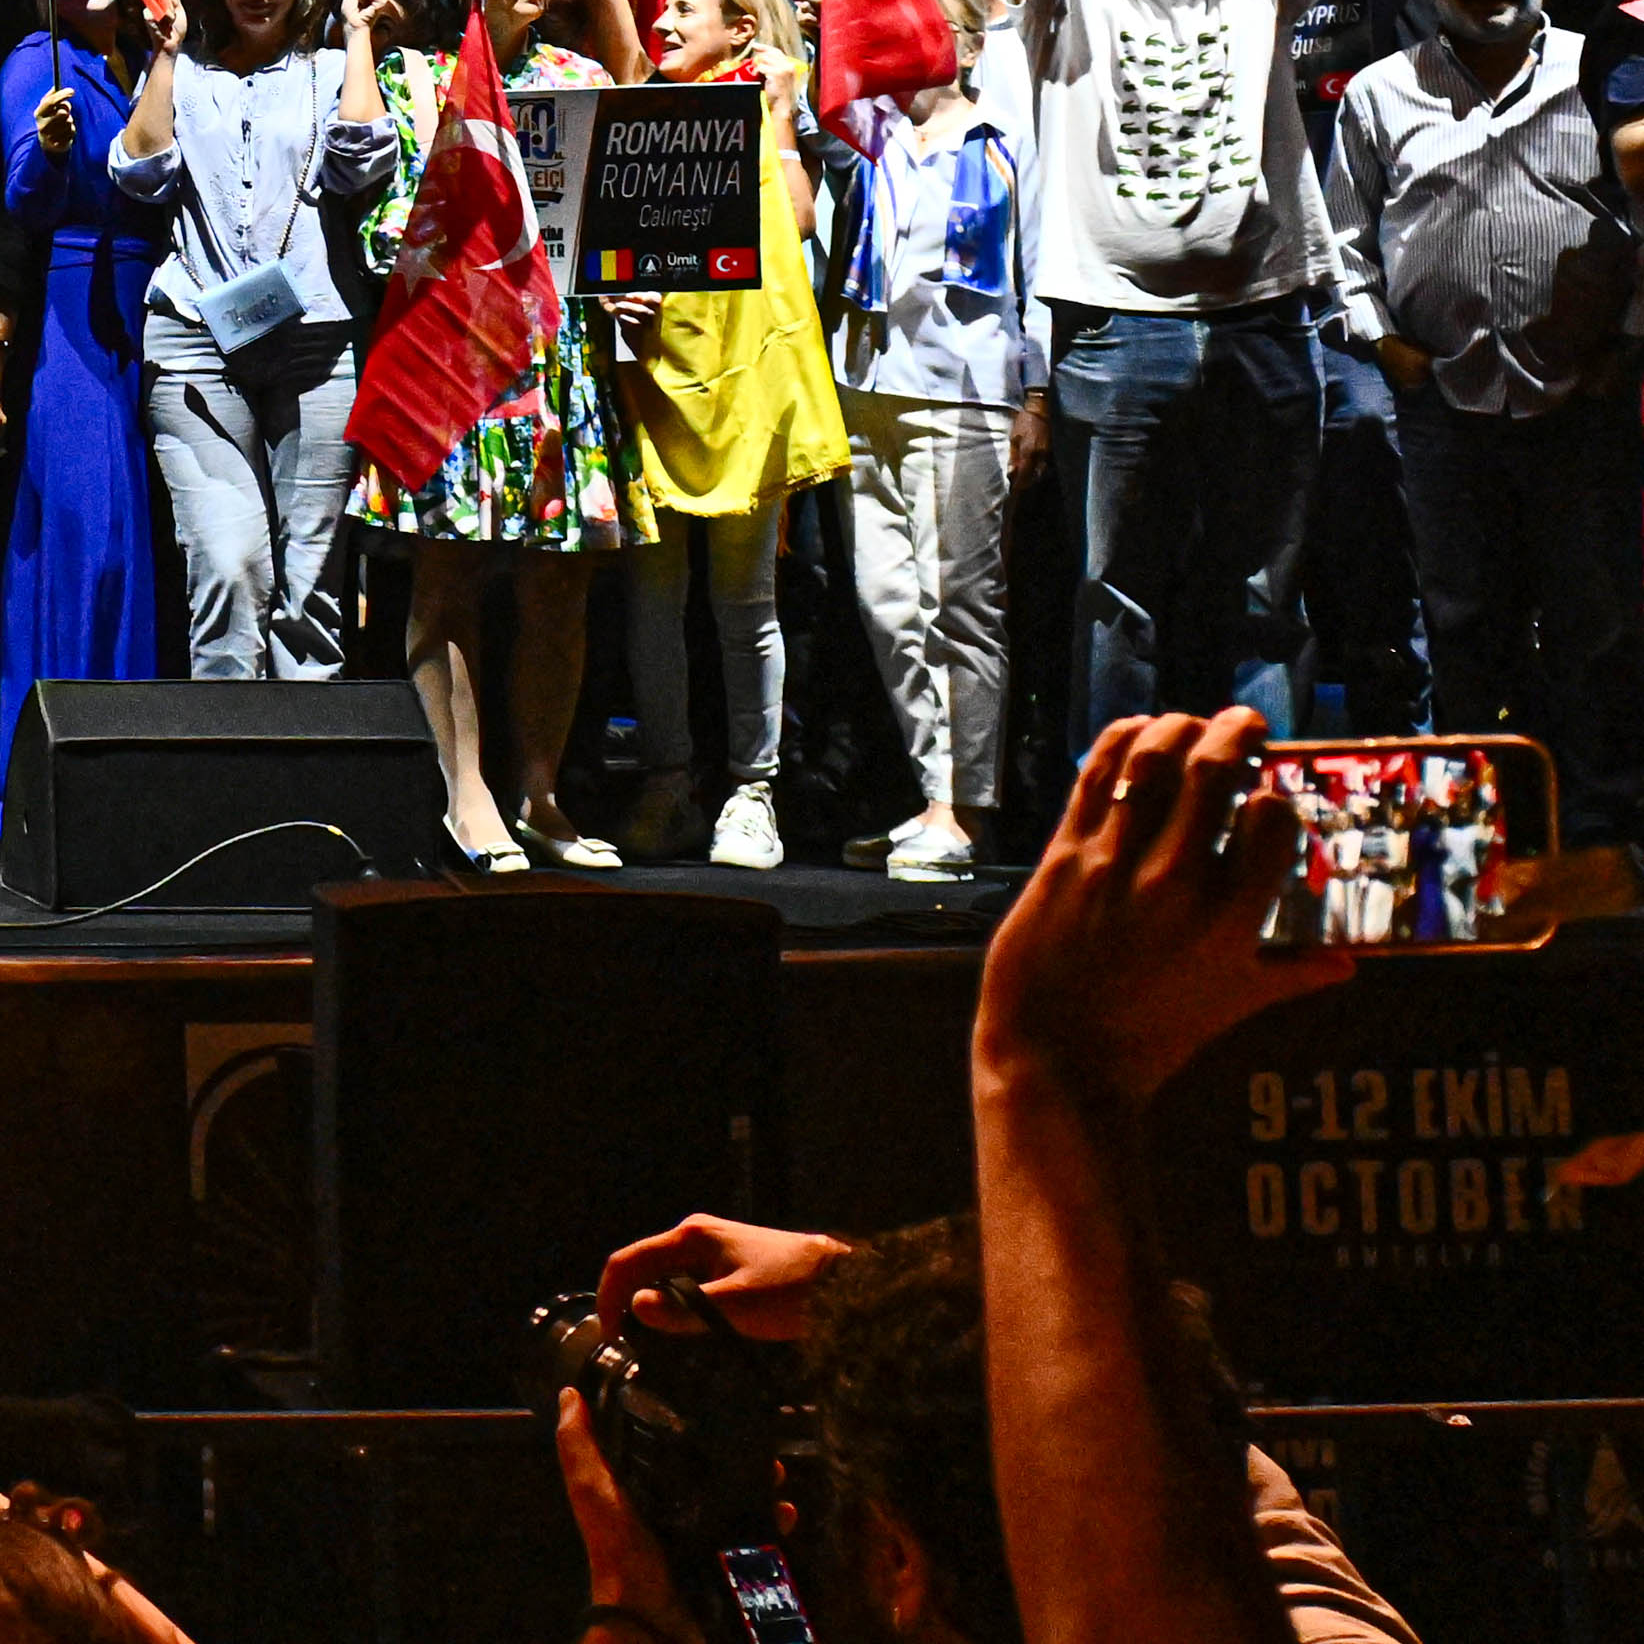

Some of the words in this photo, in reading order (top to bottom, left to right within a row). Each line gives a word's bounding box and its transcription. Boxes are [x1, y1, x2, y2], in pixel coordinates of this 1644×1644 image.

[606, 119, 745, 155] ROMANYA
[600, 160, 741, 199] ROMANIA
[1248, 1068, 1391, 1142] 9-12
[1412, 1050, 1575, 1140] EKİM
[1246, 1157, 1585, 1238] OCTOBER
